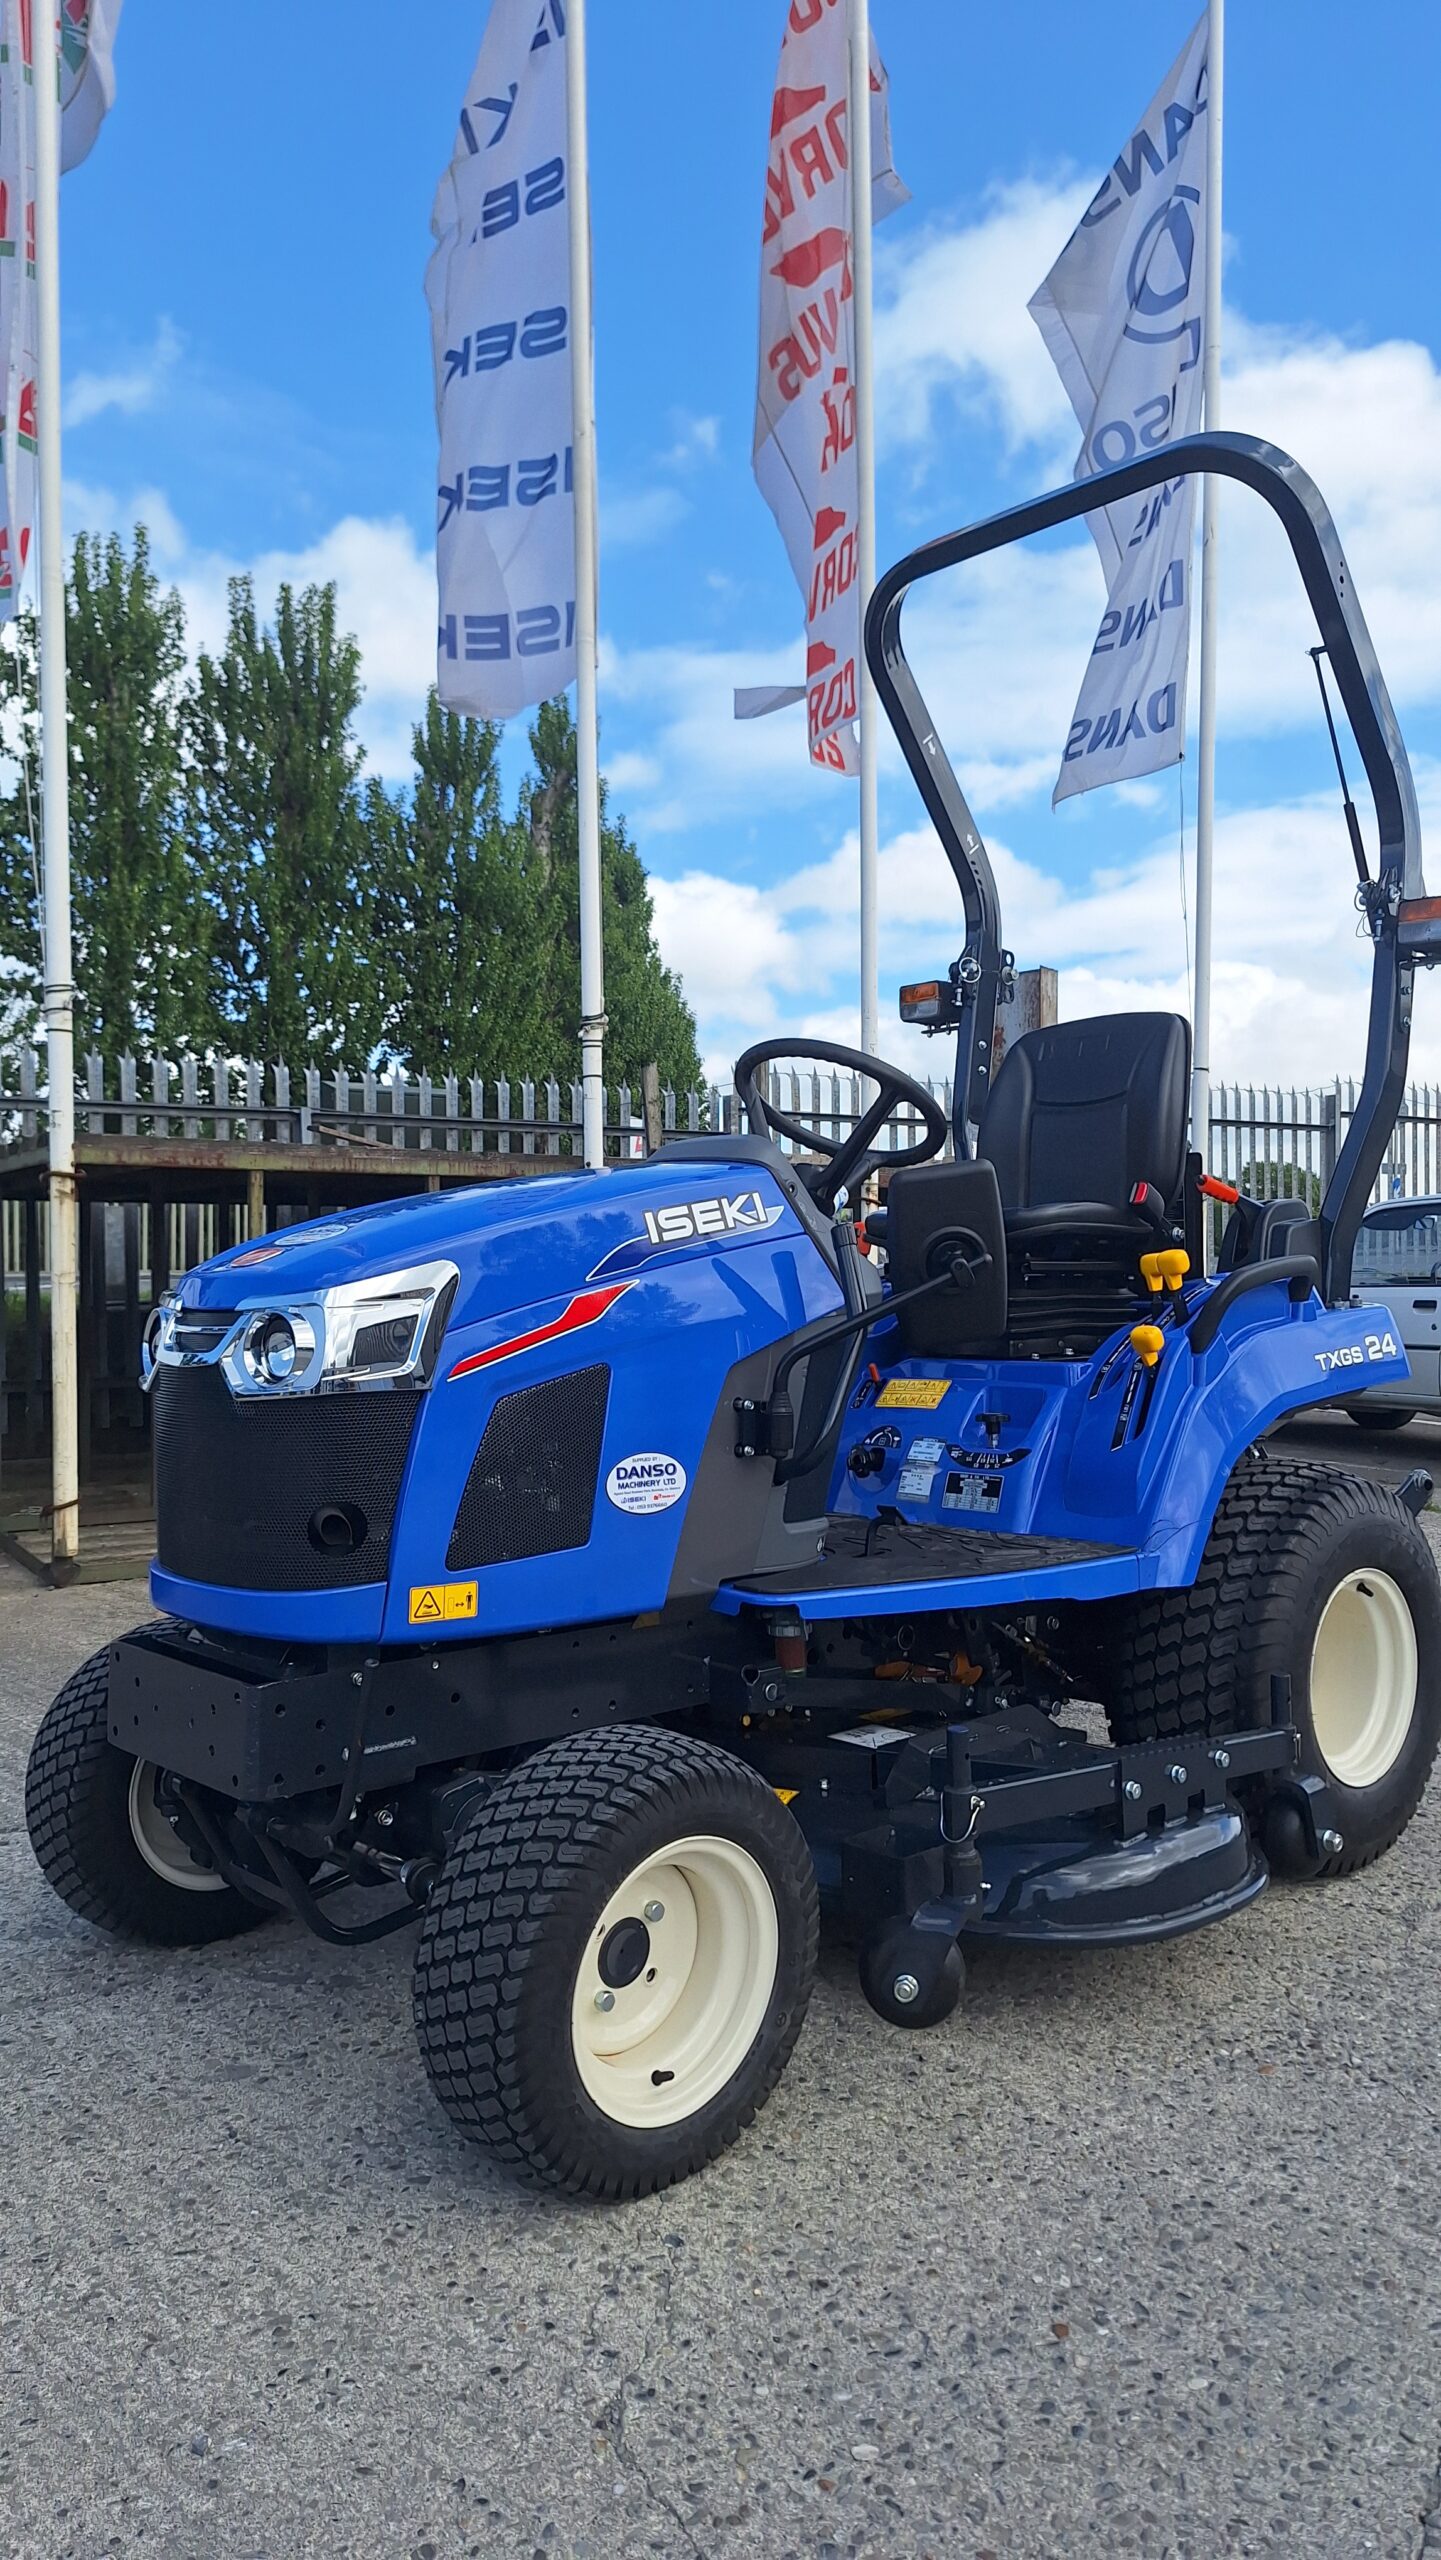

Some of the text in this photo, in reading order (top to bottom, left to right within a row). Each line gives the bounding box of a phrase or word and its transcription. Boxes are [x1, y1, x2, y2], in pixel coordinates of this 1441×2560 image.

[644, 1191, 768, 1244] ISEKI
[1314, 1332, 1397, 1371] TXGS 24
[616, 1462, 678, 1480] DANSO
[618, 1478, 677, 1490] MACHINERY LTD
